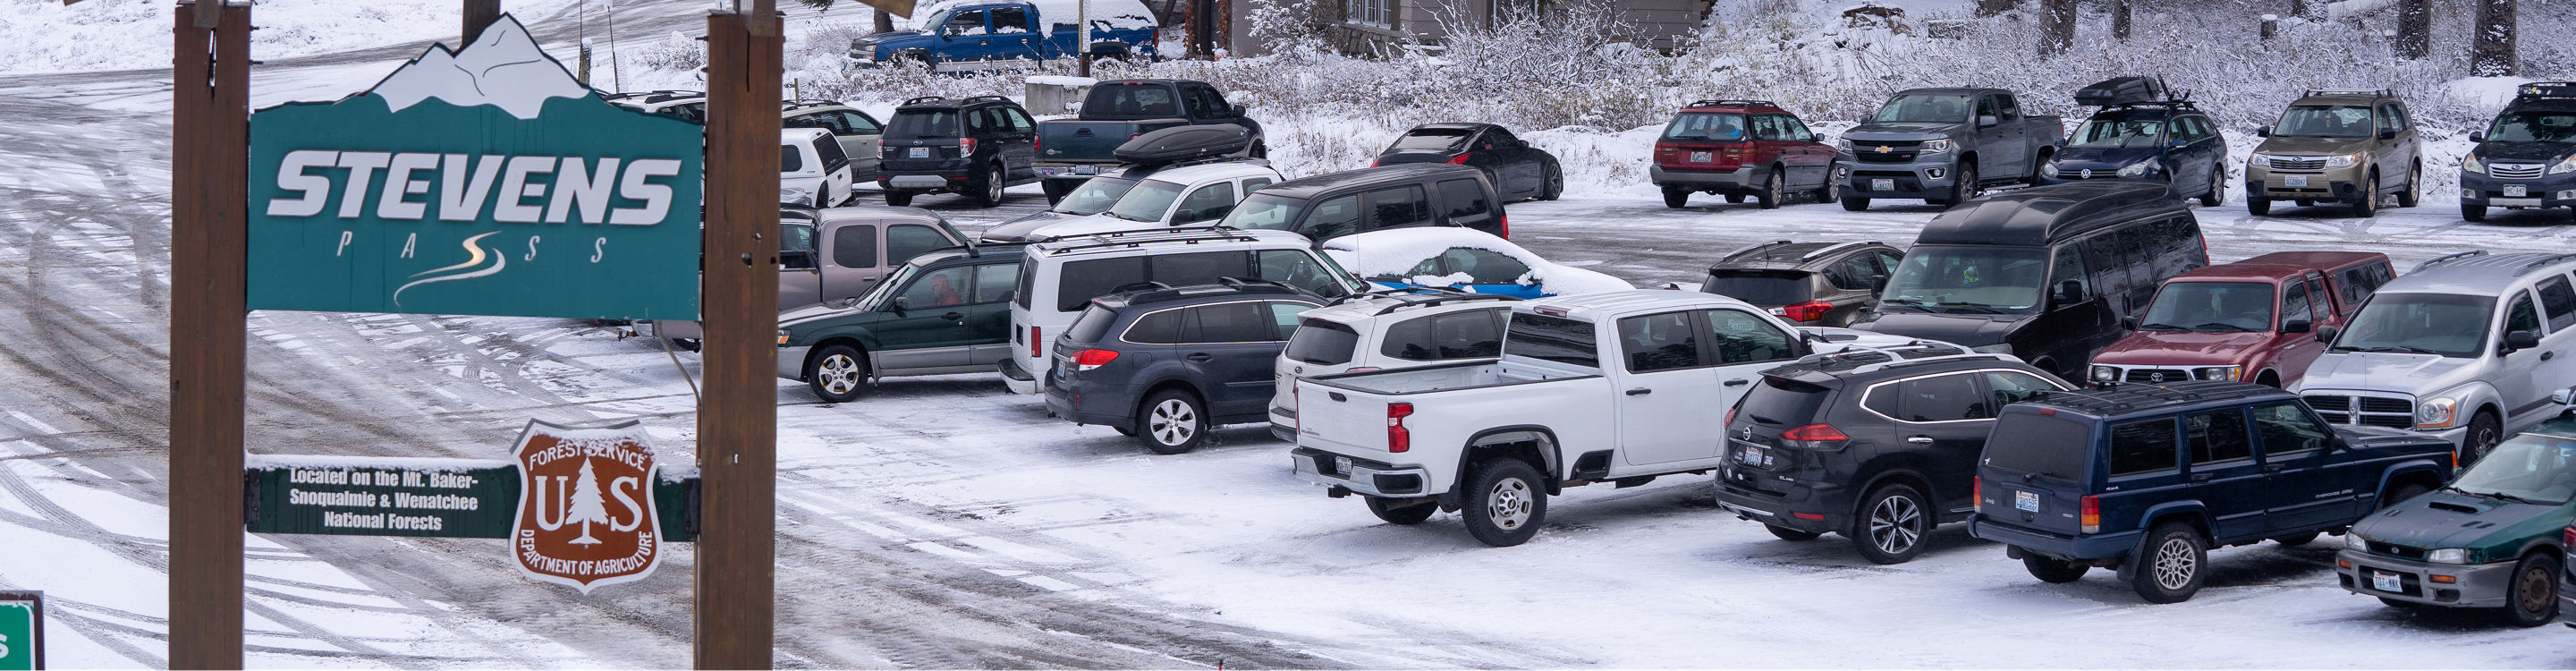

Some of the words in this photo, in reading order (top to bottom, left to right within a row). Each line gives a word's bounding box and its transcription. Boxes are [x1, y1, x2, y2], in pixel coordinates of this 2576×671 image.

[266, 149, 682, 226] STEVENS
[336, 230, 607, 263] PASS
[529, 443, 581, 471] FOREST
[290, 468, 348, 485] Located
[352, 471, 371, 485] on
[375, 471, 399, 487] the
[402, 471, 426, 488] Mt.
[430, 472, 479, 489] Baker-
[290, 488, 377, 507] Snoqualmie
[379, 494, 391, 508] &
[394, 492, 479, 511] Wenatchee
[324, 511, 385, 529] National
[388, 513, 443, 531] Forests
[520, 529, 578, 575] DEPARTMENT
[579, 560, 594, 575] OF
[594, 531, 653, 575] AGRICULTURE
